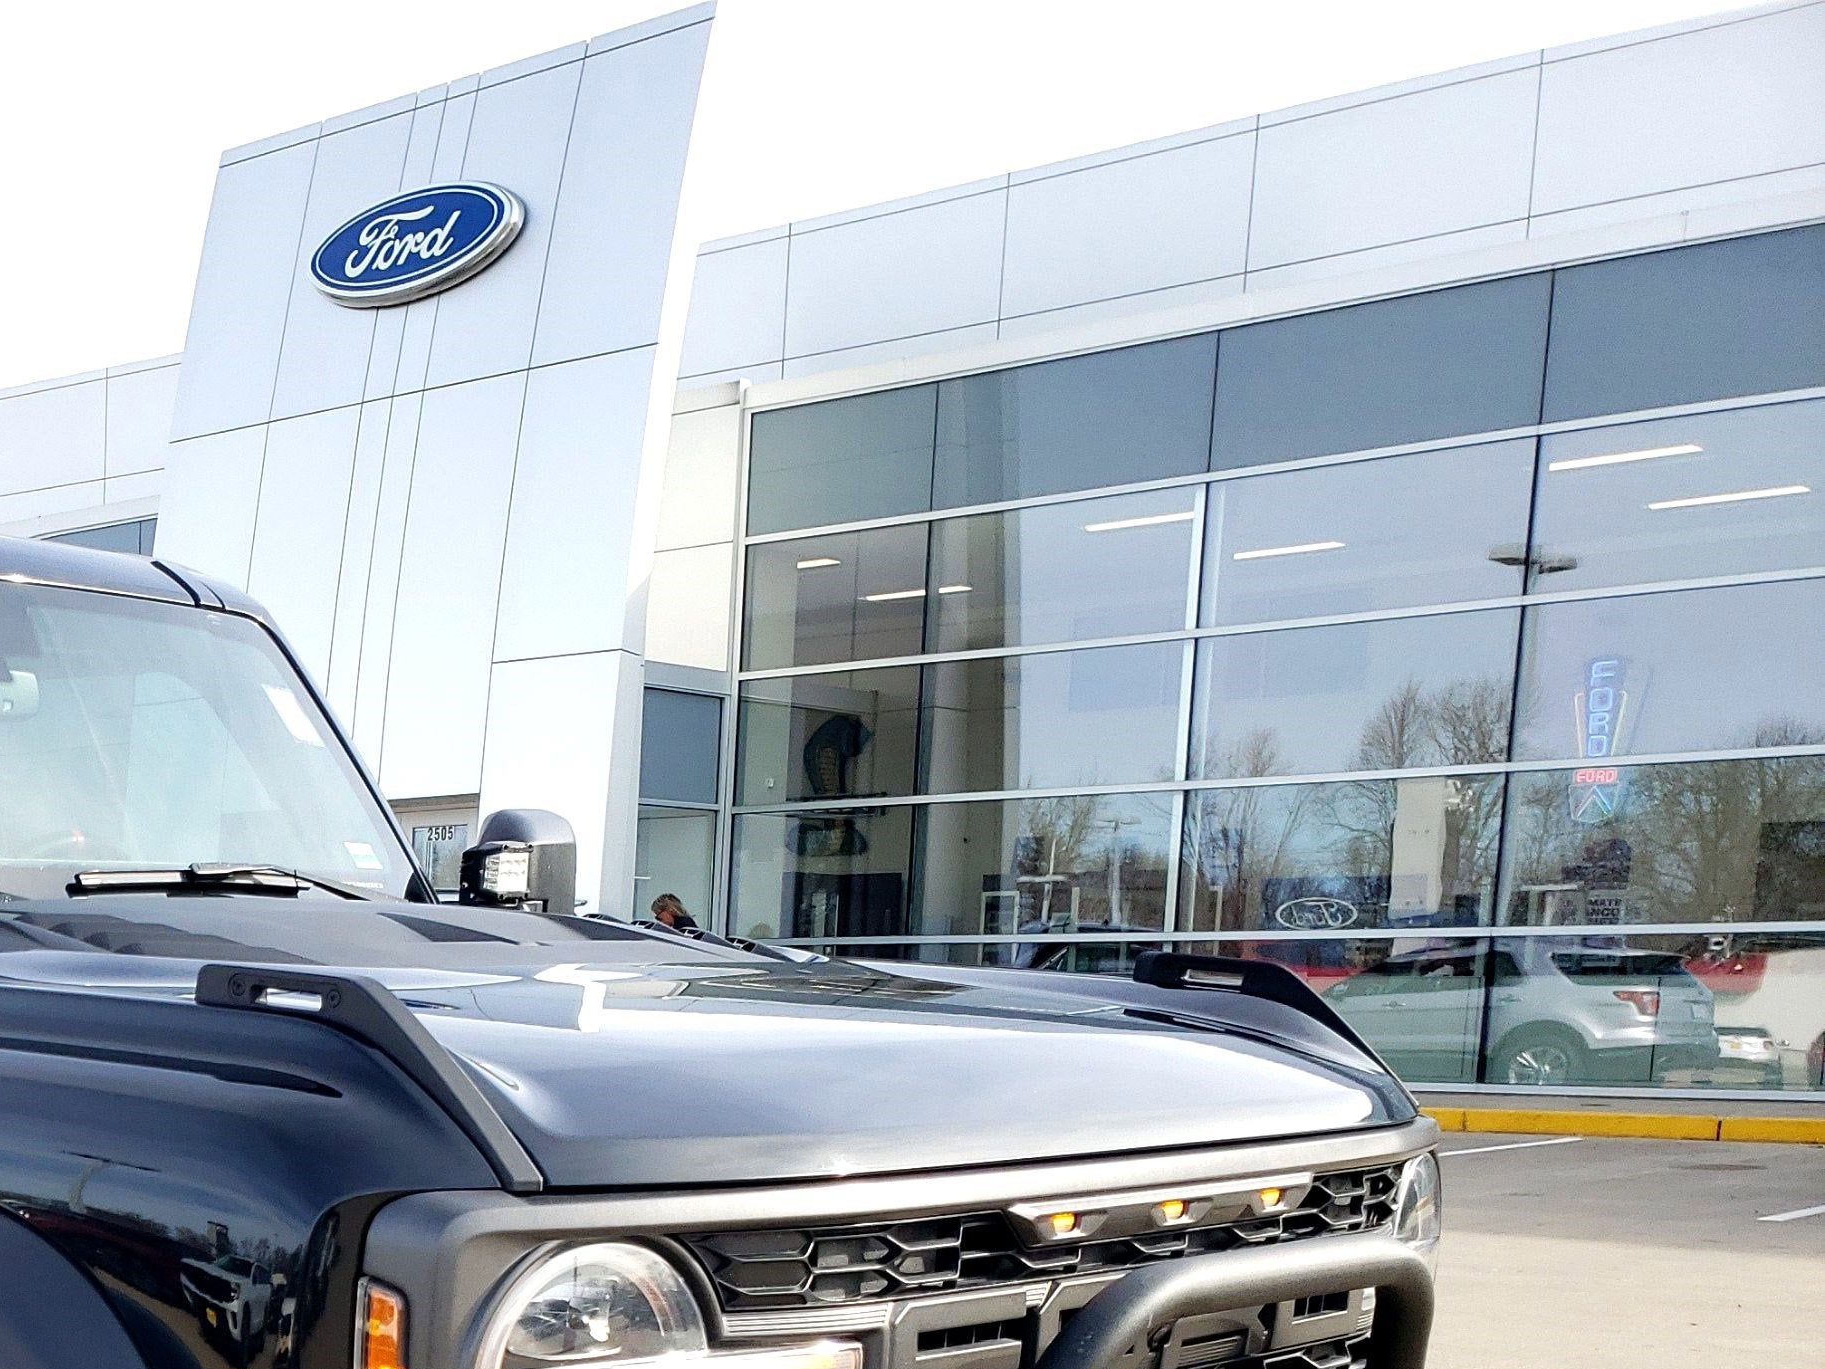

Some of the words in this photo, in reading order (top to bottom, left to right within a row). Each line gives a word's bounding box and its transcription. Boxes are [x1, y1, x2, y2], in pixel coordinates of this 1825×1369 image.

[344, 205, 462, 278] Ford
[1588, 659, 1620, 758] FORD
[1575, 769, 1616, 784] FORD
[426, 826, 455, 841] 2505
